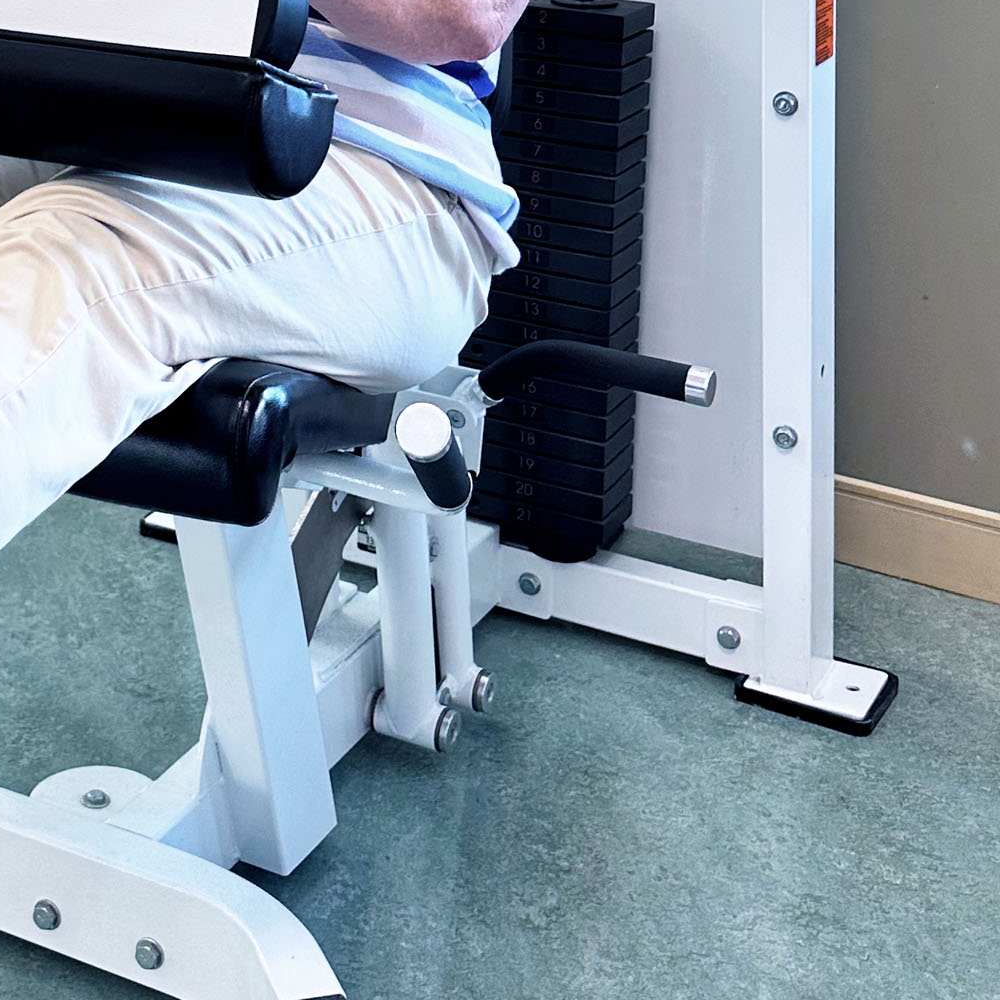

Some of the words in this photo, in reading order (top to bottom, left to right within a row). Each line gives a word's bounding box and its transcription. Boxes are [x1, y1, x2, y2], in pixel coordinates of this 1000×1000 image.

[539, 10, 547, 23] 2
[537, 37, 545, 50] 3
[537, 64, 545, 76] 4
[536, 91, 544, 104] 5
[534, 118, 542, 130] 6
[533, 144, 541, 157] 7
[531, 170, 540, 183] 8
[530, 198, 539, 210] 9
[526, 223, 542, 238] 10
[526, 250, 539, 264] 11
[525, 274, 540, 289] 12
[525, 301, 539, 316] 13
[524, 327, 538, 340] 14
[522, 405, 537, 418] 17
[520, 431, 536, 446] 18
[519, 456, 534, 470] 19
[516, 481, 533, 496] 20
[516, 508, 531, 522] 21
